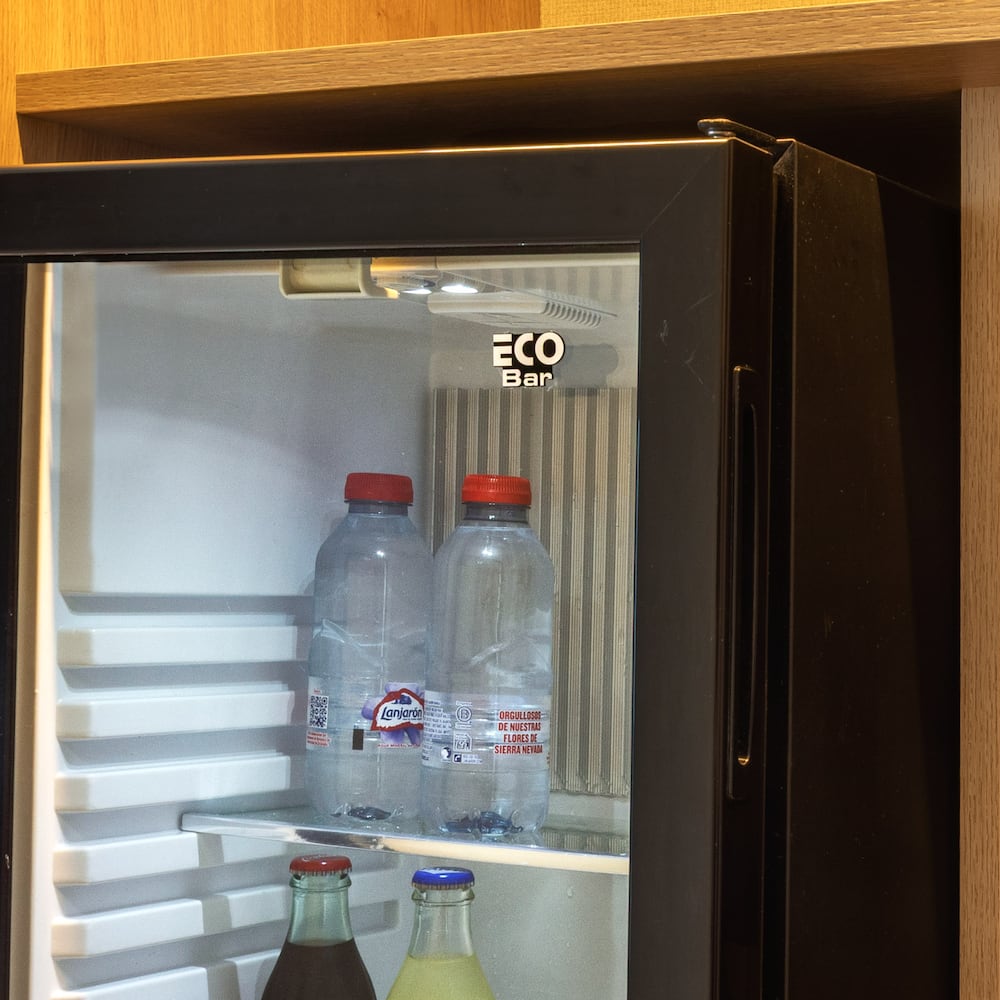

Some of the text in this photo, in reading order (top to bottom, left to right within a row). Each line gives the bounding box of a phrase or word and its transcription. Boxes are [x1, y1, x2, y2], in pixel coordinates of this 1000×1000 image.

[493, 332, 564, 367] ECO
[502, 368, 553, 387] Bar
[380, 706, 423, 721] Lanjarón
[499, 710, 541, 720] ORGULLOSOS
[498, 722, 541, 732] DE NUESTRAS
[503, 733, 538, 743] FLORES DE
[494, 745, 543, 754] SIERRA NEVADA
